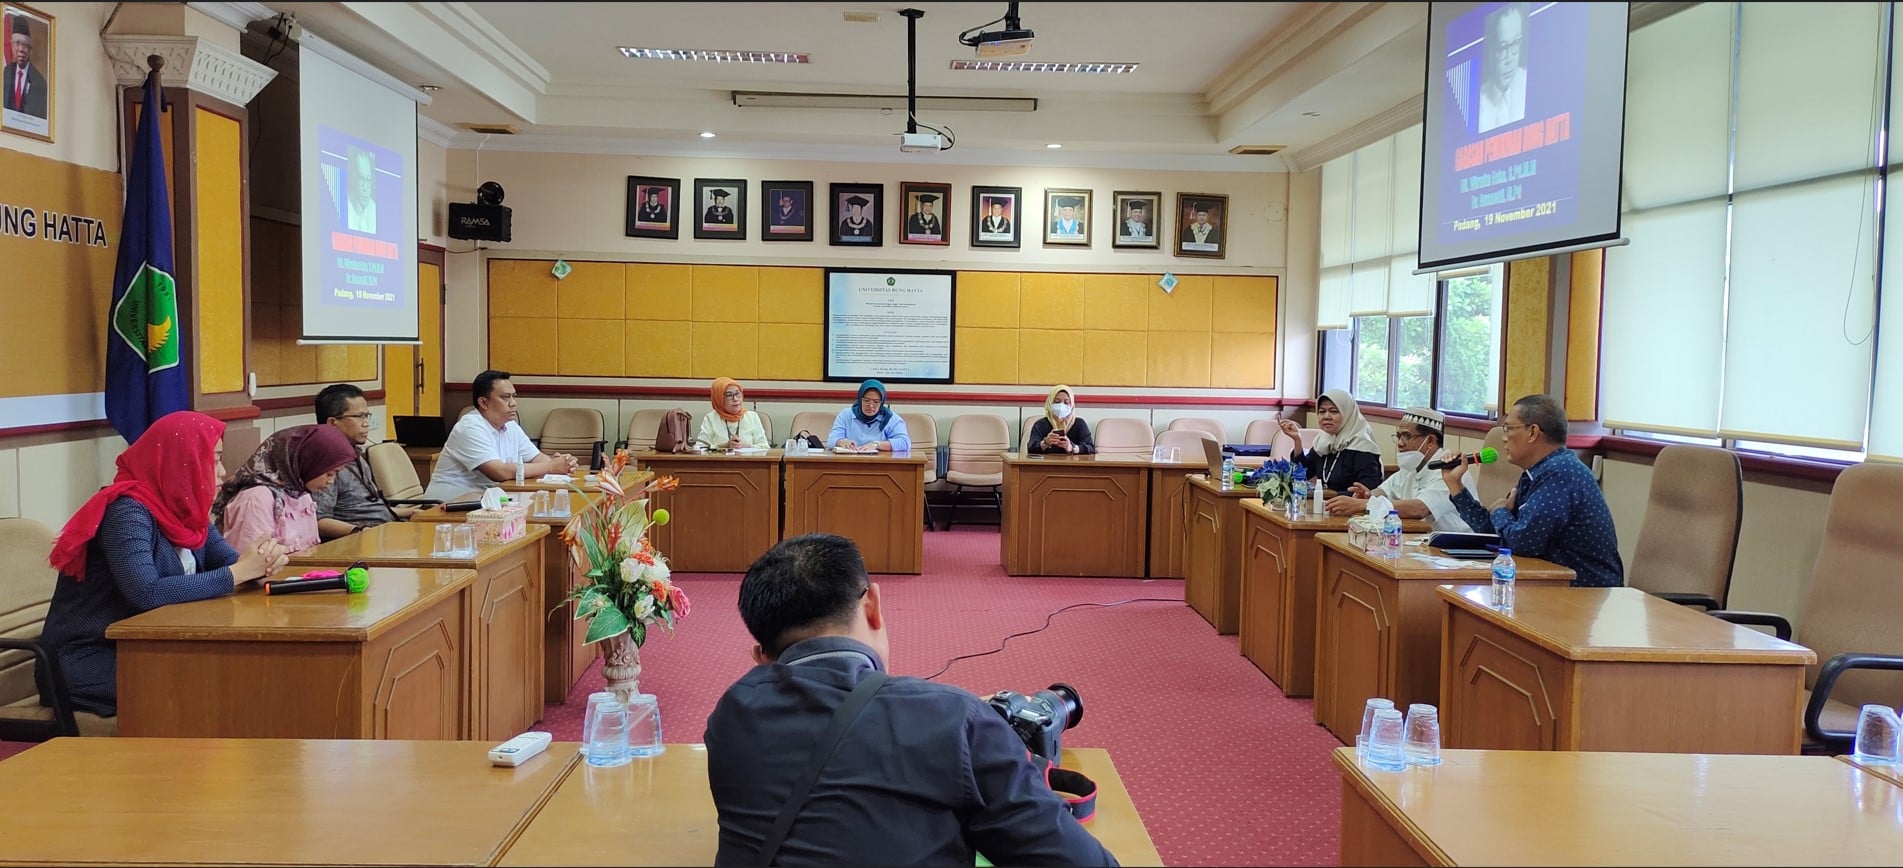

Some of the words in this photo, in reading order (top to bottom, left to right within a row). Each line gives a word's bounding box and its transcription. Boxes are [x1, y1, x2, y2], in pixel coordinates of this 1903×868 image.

[0, 203, 37, 238] NG
[43, 211, 108, 248] HATTA
[460, 216, 491, 226] RAMSA
[1453, 218, 1481, 232] Padang,
[1484, 213, 1494, 226] 19
[1494, 206, 1535, 224] November
[1535, 201, 1557, 216] 2021
